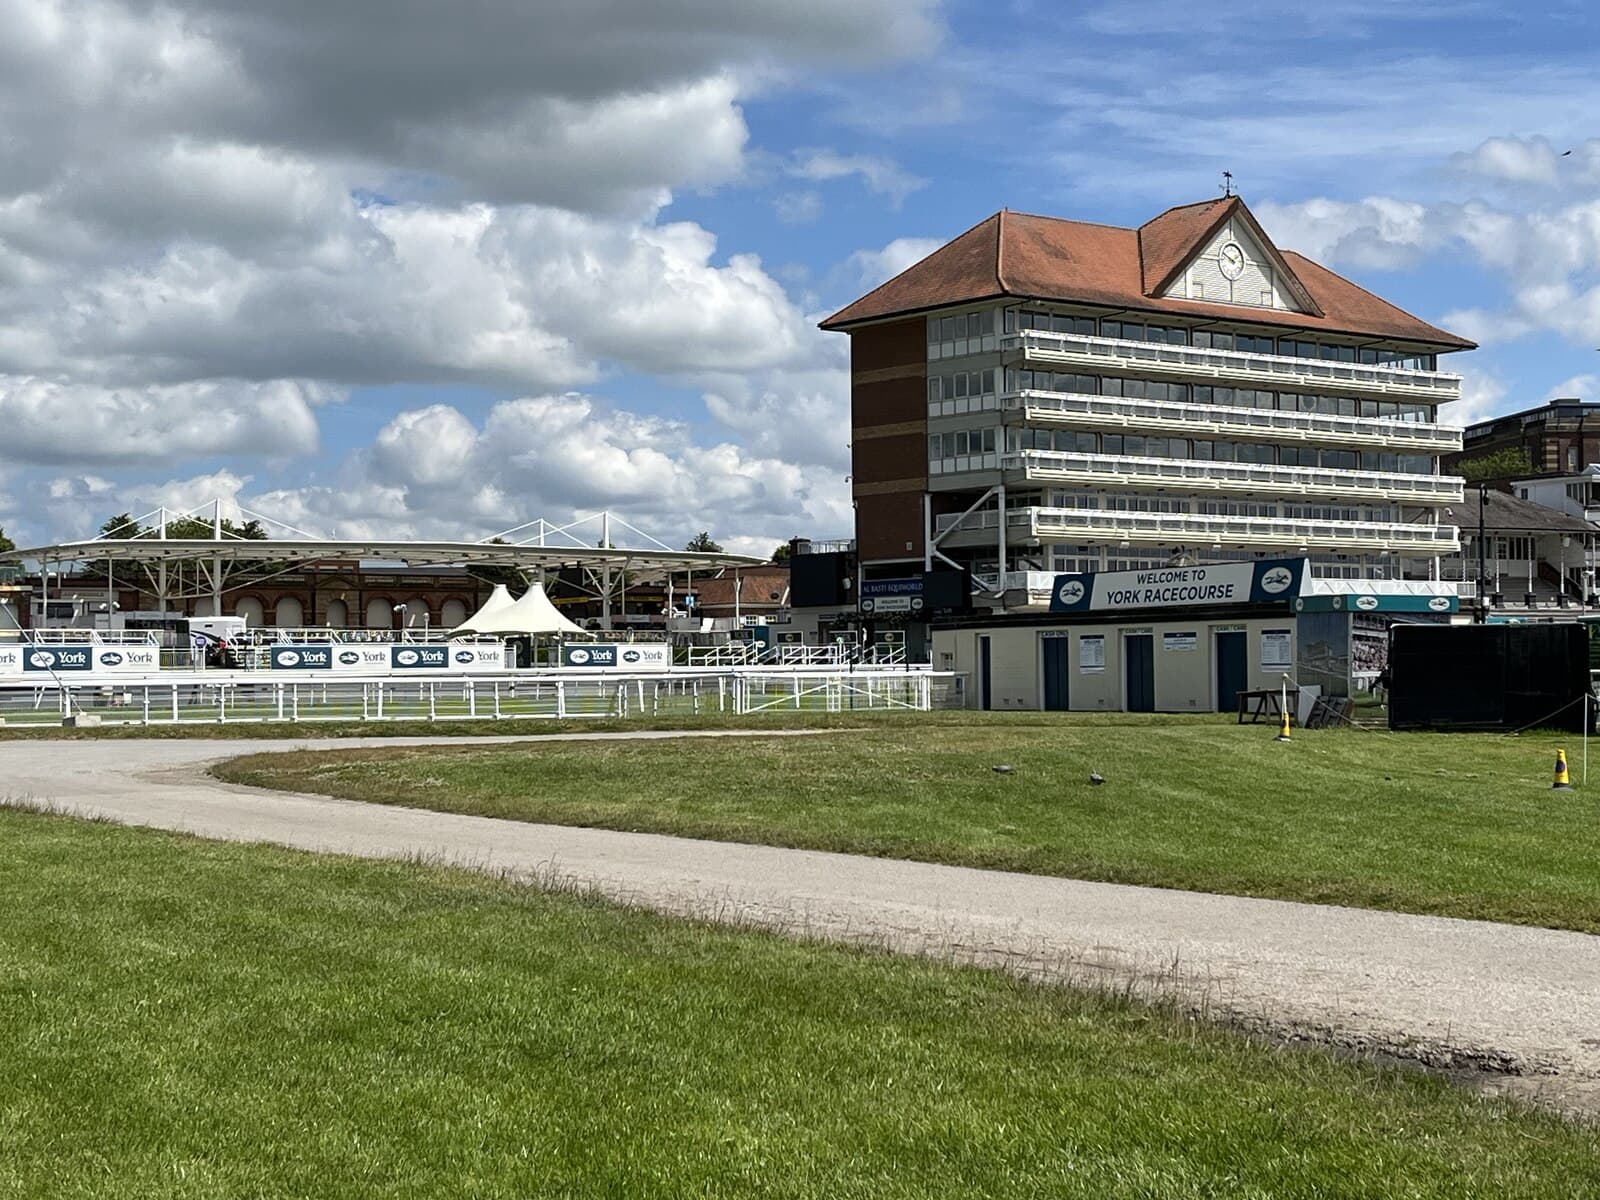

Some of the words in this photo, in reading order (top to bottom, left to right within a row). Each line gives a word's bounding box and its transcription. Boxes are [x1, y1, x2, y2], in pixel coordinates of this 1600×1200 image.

[1137, 571, 1189, 585] WELCOME
[1192, 569, 1206, 581] TO
[1106, 589, 1141, 605] YORK
[1144, 584, 1234, 602] RACECOURSE
[58, 652, 86, 664] York
[127, 652, 153, 663] York
[301, 651, 327, 662] York
[362, 651, 386, 662] York
[420, 650, 444, 661] York
[477, 650, 500, 661] York
[591, 650, 613, 660] York
[643, 650, 663, 660] York
